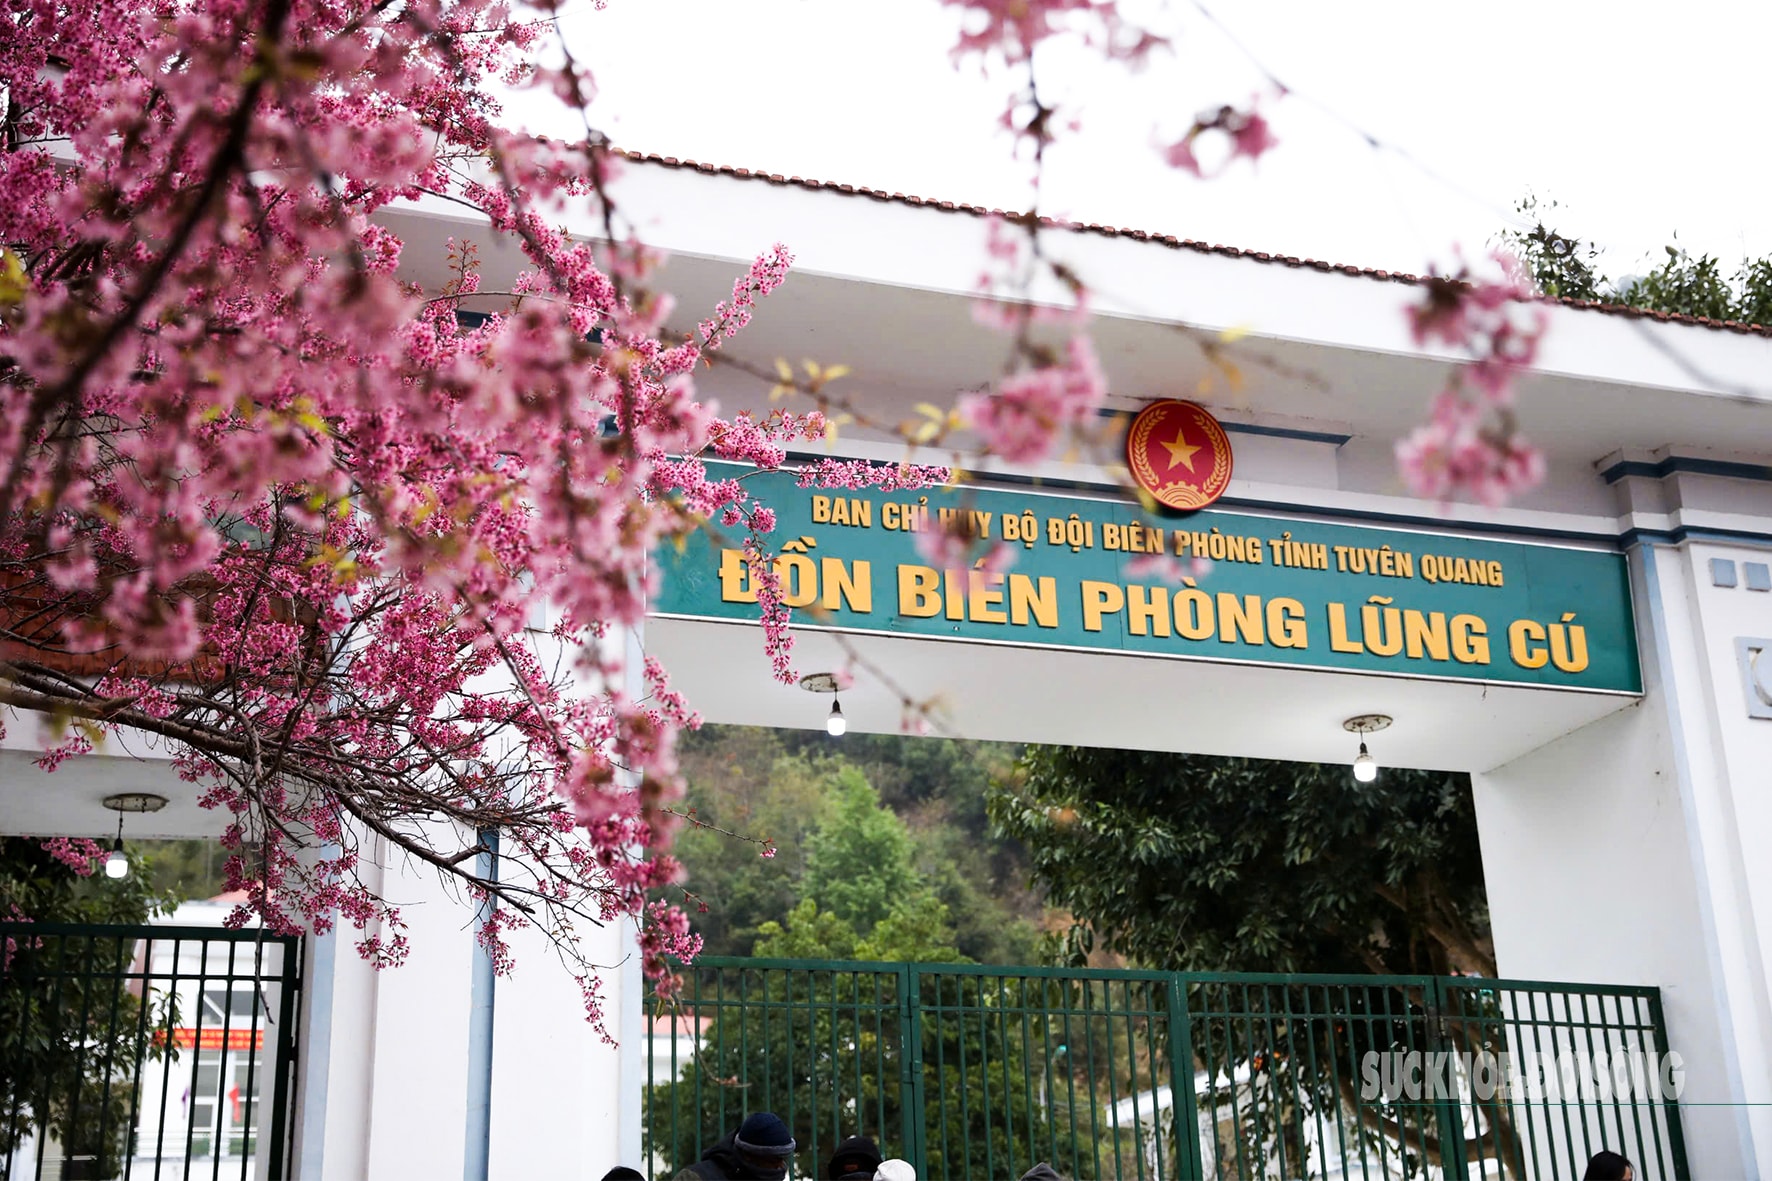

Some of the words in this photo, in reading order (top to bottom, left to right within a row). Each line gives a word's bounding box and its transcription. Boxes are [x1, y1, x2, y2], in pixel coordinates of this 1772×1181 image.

[812, 495, 871, 528] BAN
[882, 496, 929, 532] CHỈ
[1002, 510, 1038, 548] BỘ
[1047, 514, 1093, 552] ĐỘI
[1102, 520, 1164, 554] BIÊN
[1173, 527, 1263, 563] PHÒNG
[1269, 532, 1328, 570] TỈNH
[1334, 545, 1412, 578] TUYÊN
[1421, 554, 1503, 587] QUANG
[718, 536, 872, 612] ĐỒN
[1081, 576, 1308, 649] PHÒNG
[1328, 595, 1491, 665] LŨNG
[1508, 613, 1589, 673] CÚ
